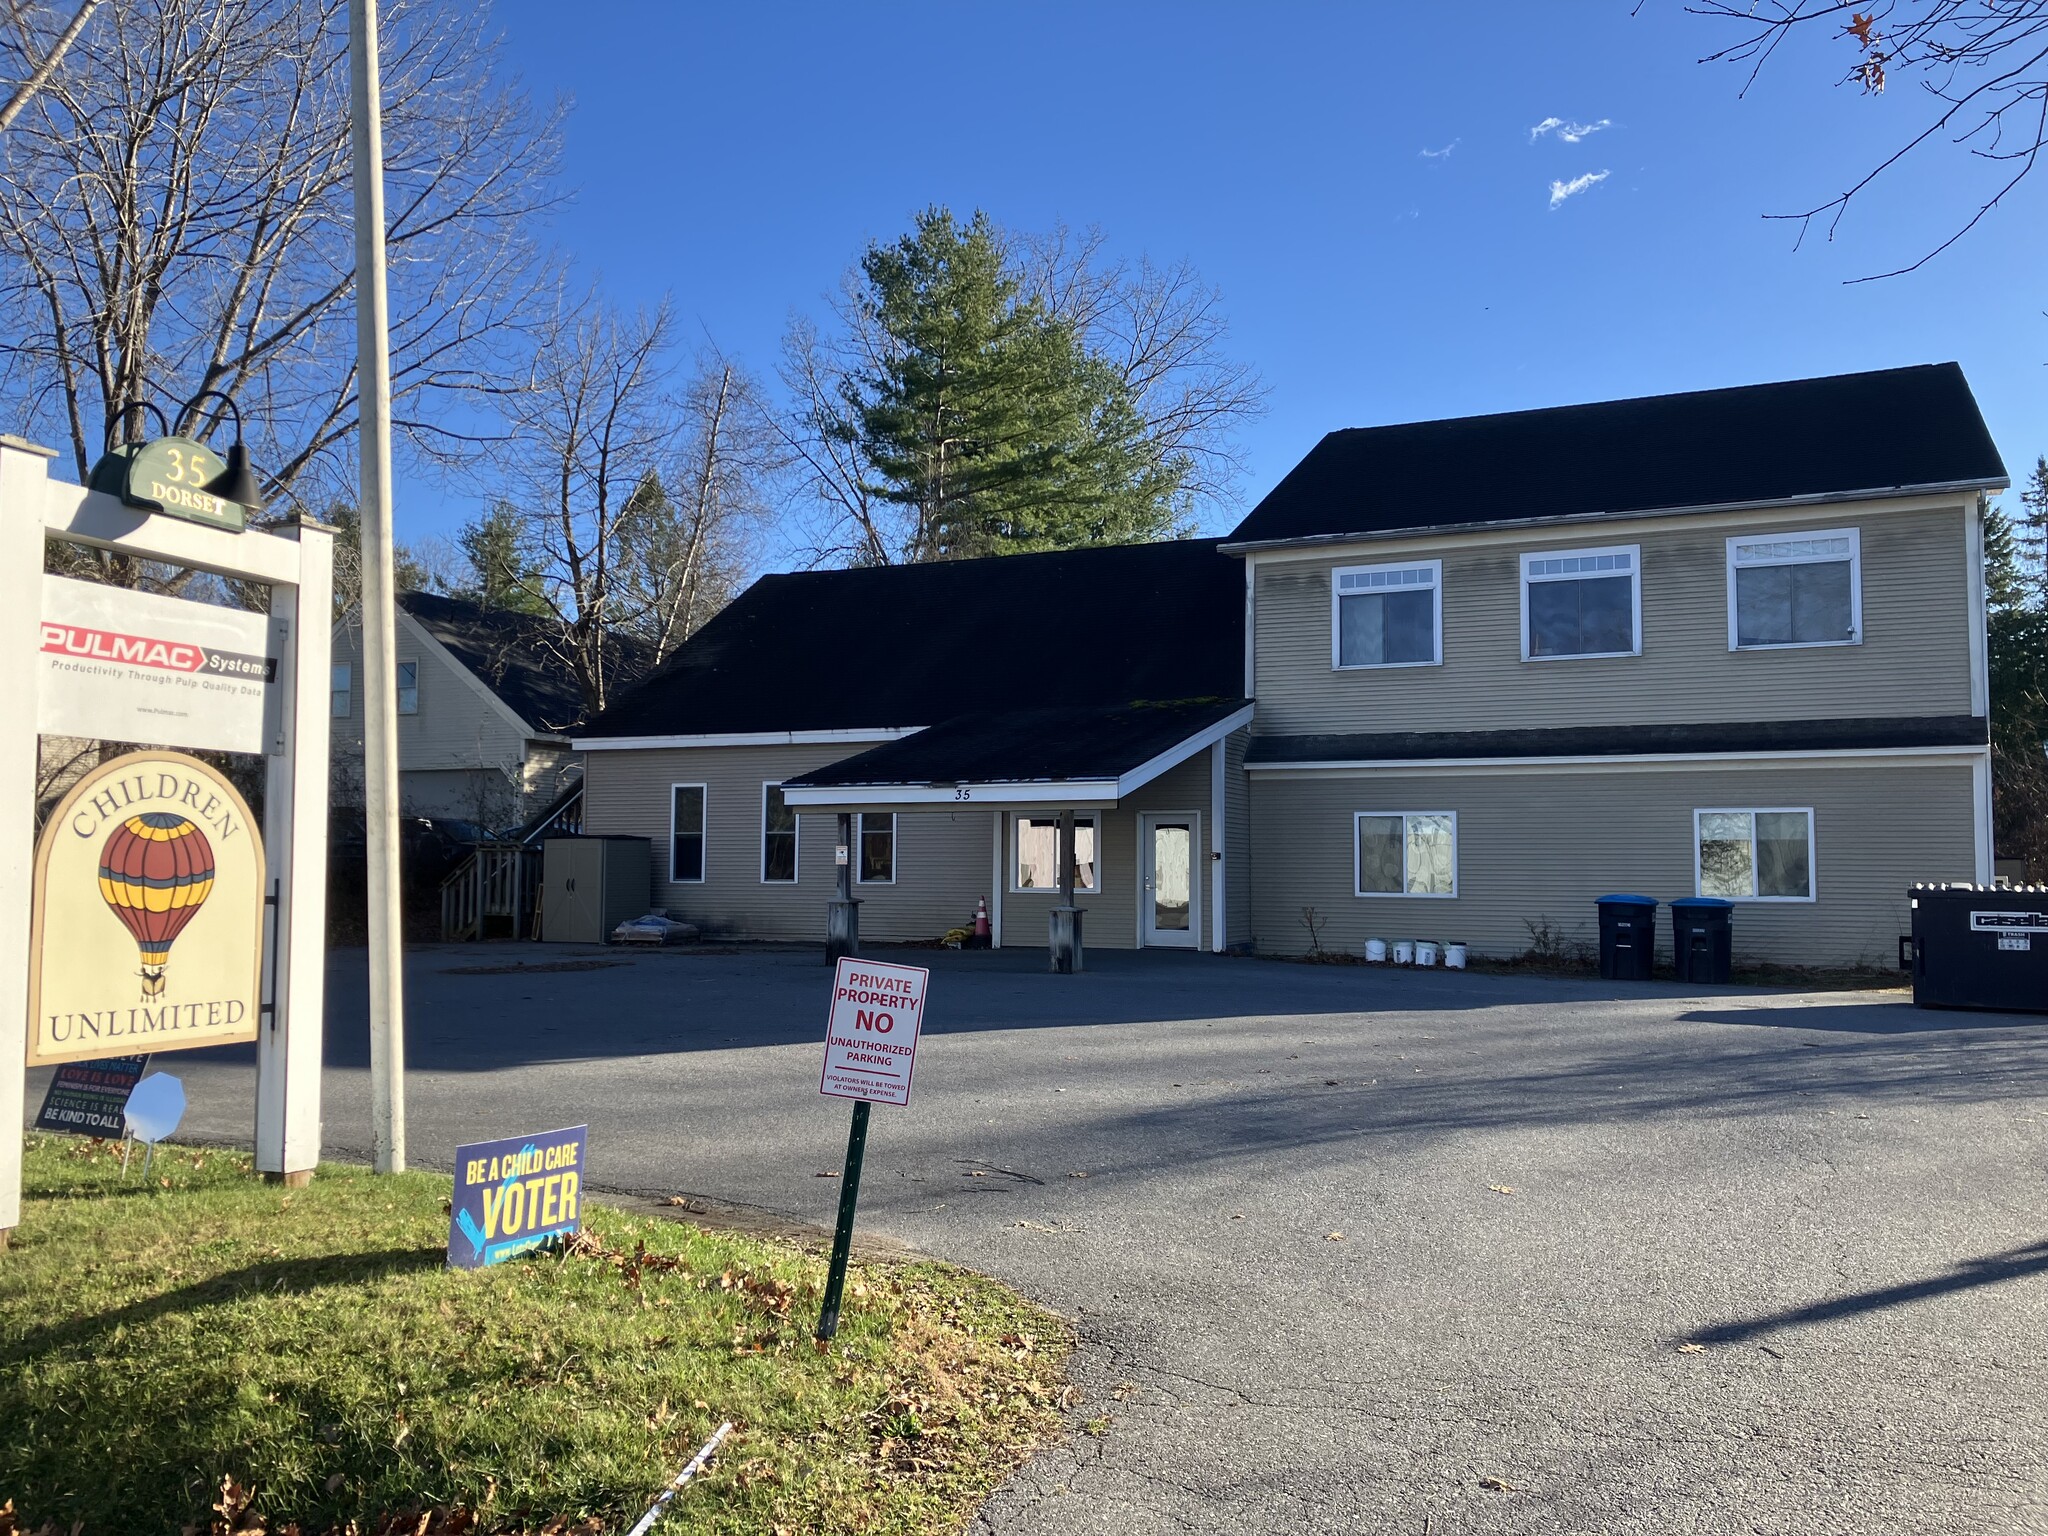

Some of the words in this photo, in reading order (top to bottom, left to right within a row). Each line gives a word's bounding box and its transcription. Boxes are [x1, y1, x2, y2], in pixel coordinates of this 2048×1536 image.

[166, 448, 208, 488] 35
[152, 481, 227, 515] DORSET
[41, 626, 196, 669] PULMAC
[209, 655, 271, 677] Systems
[51, 660, 124, 679] Productivity
[128, 670, 172, 685] Through
[175, 677, 198, 689] Pulp
[202, 680, 238, 695] Quality
[240, 686, 262, 697] Data
[72, 773, 240, 841] CHILDREN
[955, 789, 971, 801] 35
[849, 972, 912, 994] PRIVATE
[837, 987, 919, 1011] PROPERTY
[48, 999, 245, 1042] UNLIMITED
[855, 1009, 894, 1034] NO
[830, 1036, 912, 1056] UNAUTHORIZED
[846, 1052, 892, 1066] PARKING
[61, 1068, 89, 1080] LOVE
[91, 1071, 102, 1082] IS
[104, 1073, 135, 1086] LOVE
[827, 1074, 860, 1085] VIOLATORS
[860, 1079, 875, 1087] WILL
[884, 1083, 906, 1091] TOWED
[842, 1085, 868, 1093] OWNERS
[869, 1088, 897, 1097] EXPENSE.
[44, 1108, 59, 1119] BE
[58, 1109, 86, 1123] KIND
[86, 1113, 100, 1125] TO
[100, 1115, 119, 1128] ALL
[50, 1097, 87, 1109] SCIENCE
[90, 1102, 99, 1111] IS
[102, 1104, 124, 1115] REAL
[466, 1159, 488, 1185] BE
[488, 1157, 499, 1181] A
[501, 1149, 544, 1179] CHILD
[545, 1142, 579, 1171] CARE
[482, 1171, 579, 1240] VOTER
